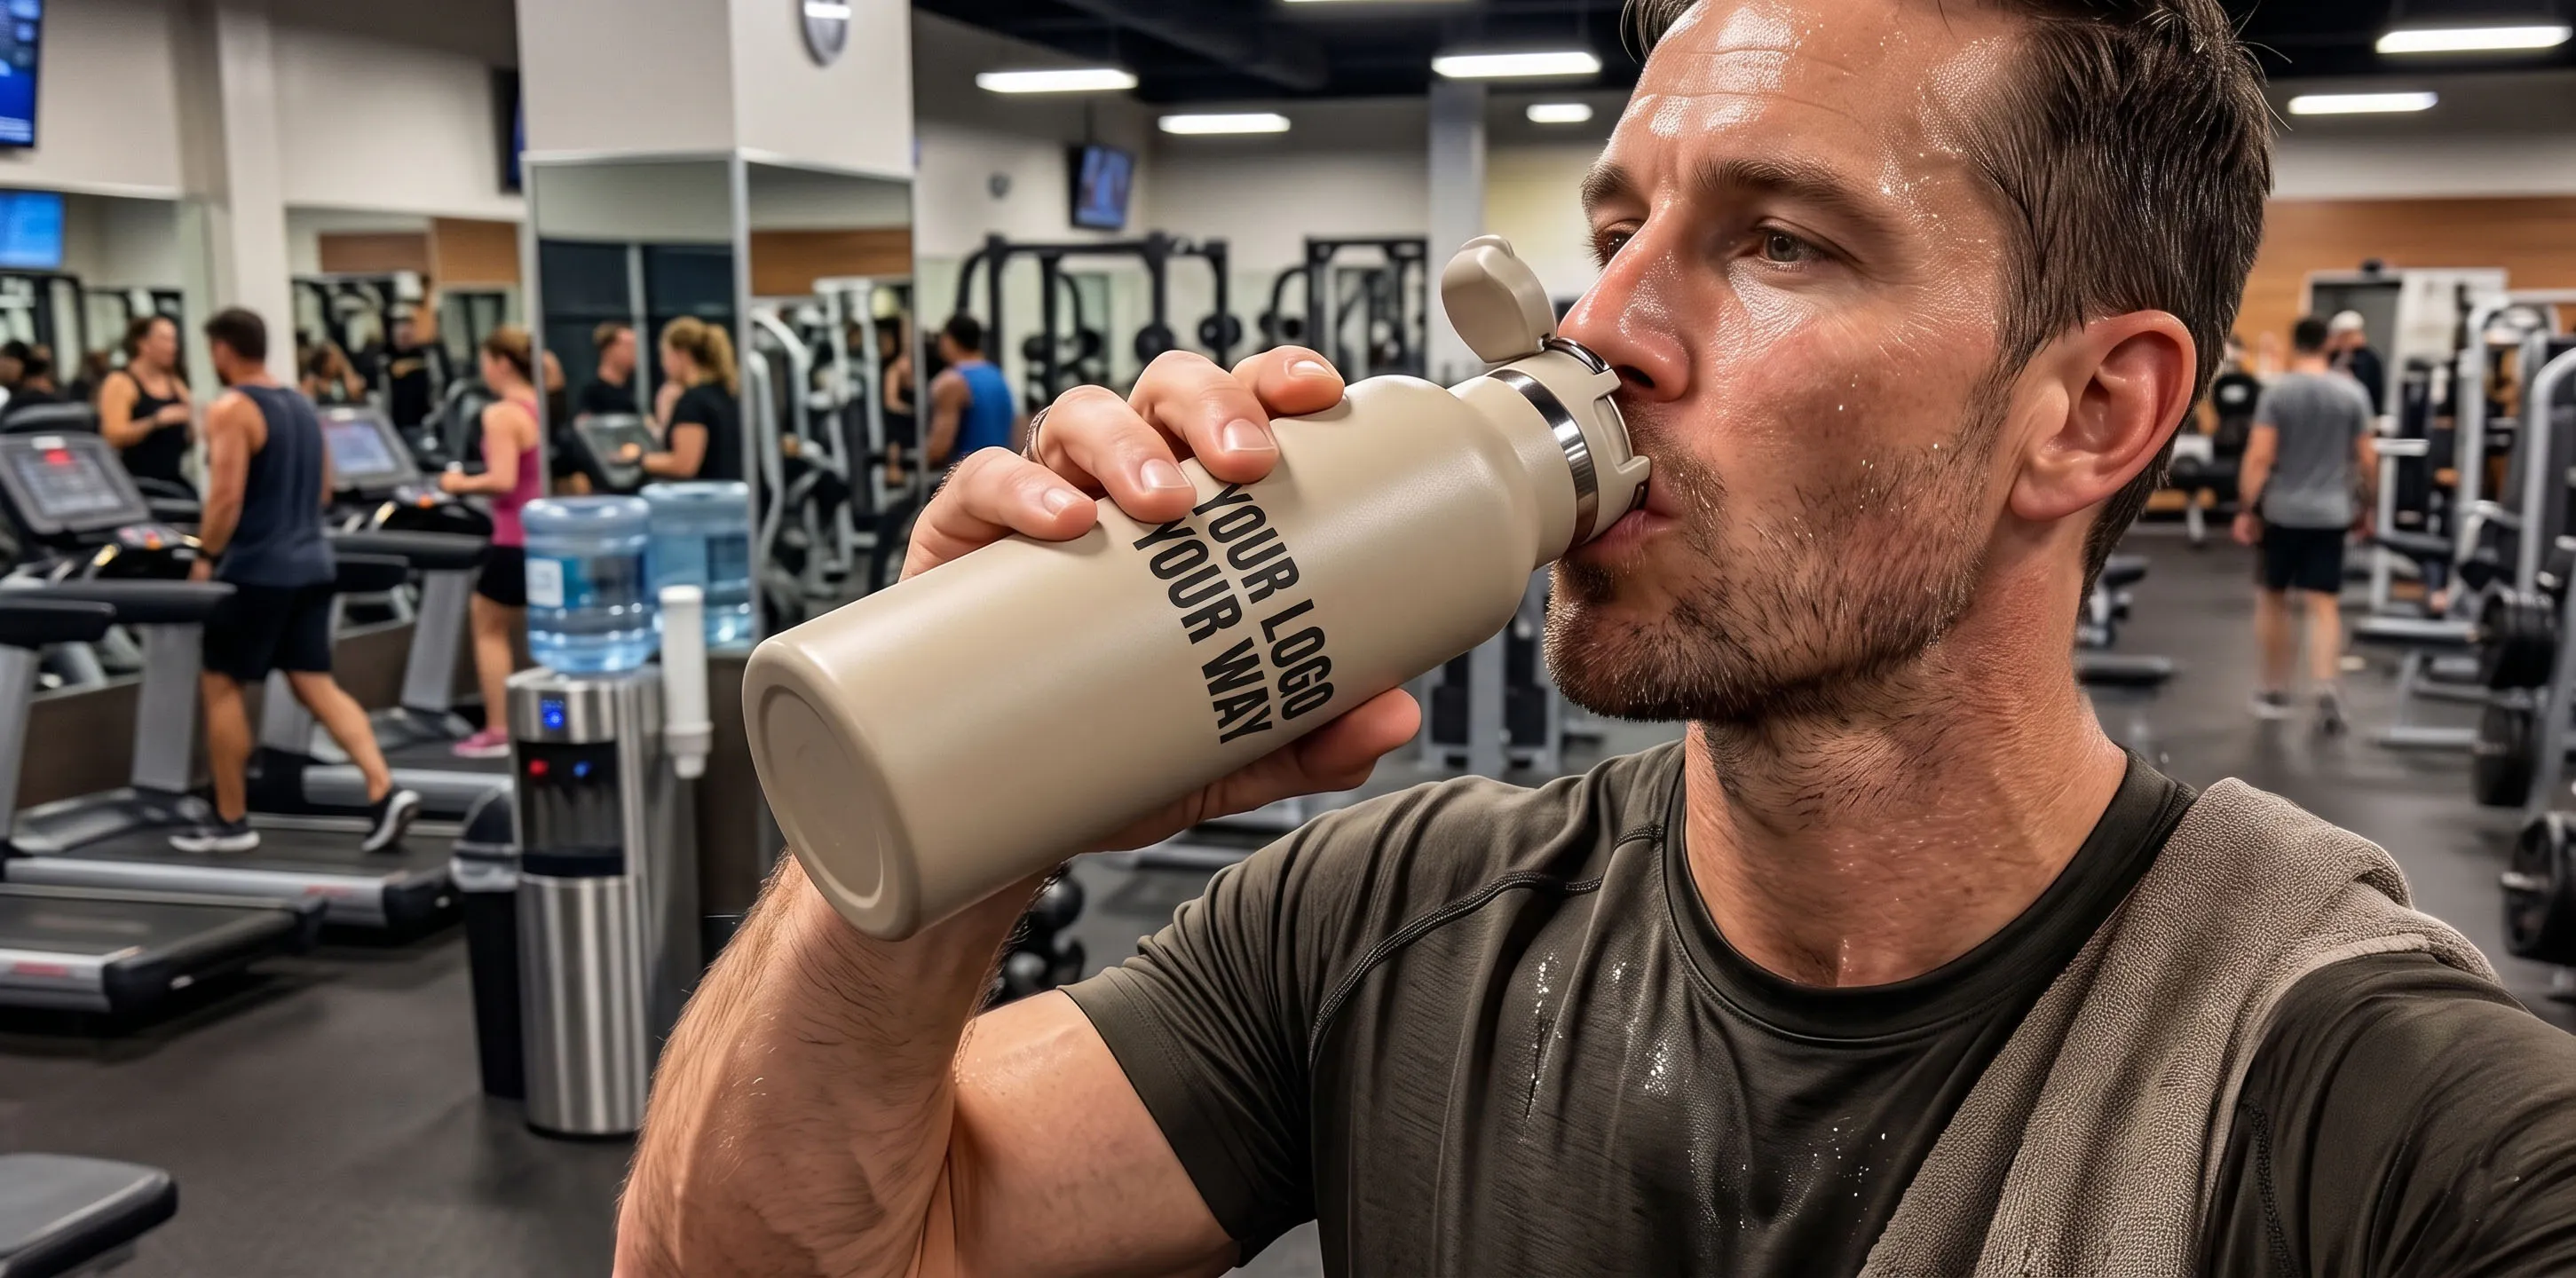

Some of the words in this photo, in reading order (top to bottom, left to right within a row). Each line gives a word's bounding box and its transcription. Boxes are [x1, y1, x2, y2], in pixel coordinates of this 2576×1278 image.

[1133, 517, 1242, 644] YOUR
[1201, 636, 1273, 745] WAY
[1191, 483, 1300, 604] YOUR
[1260, 598, 1334, 721] LOGO
